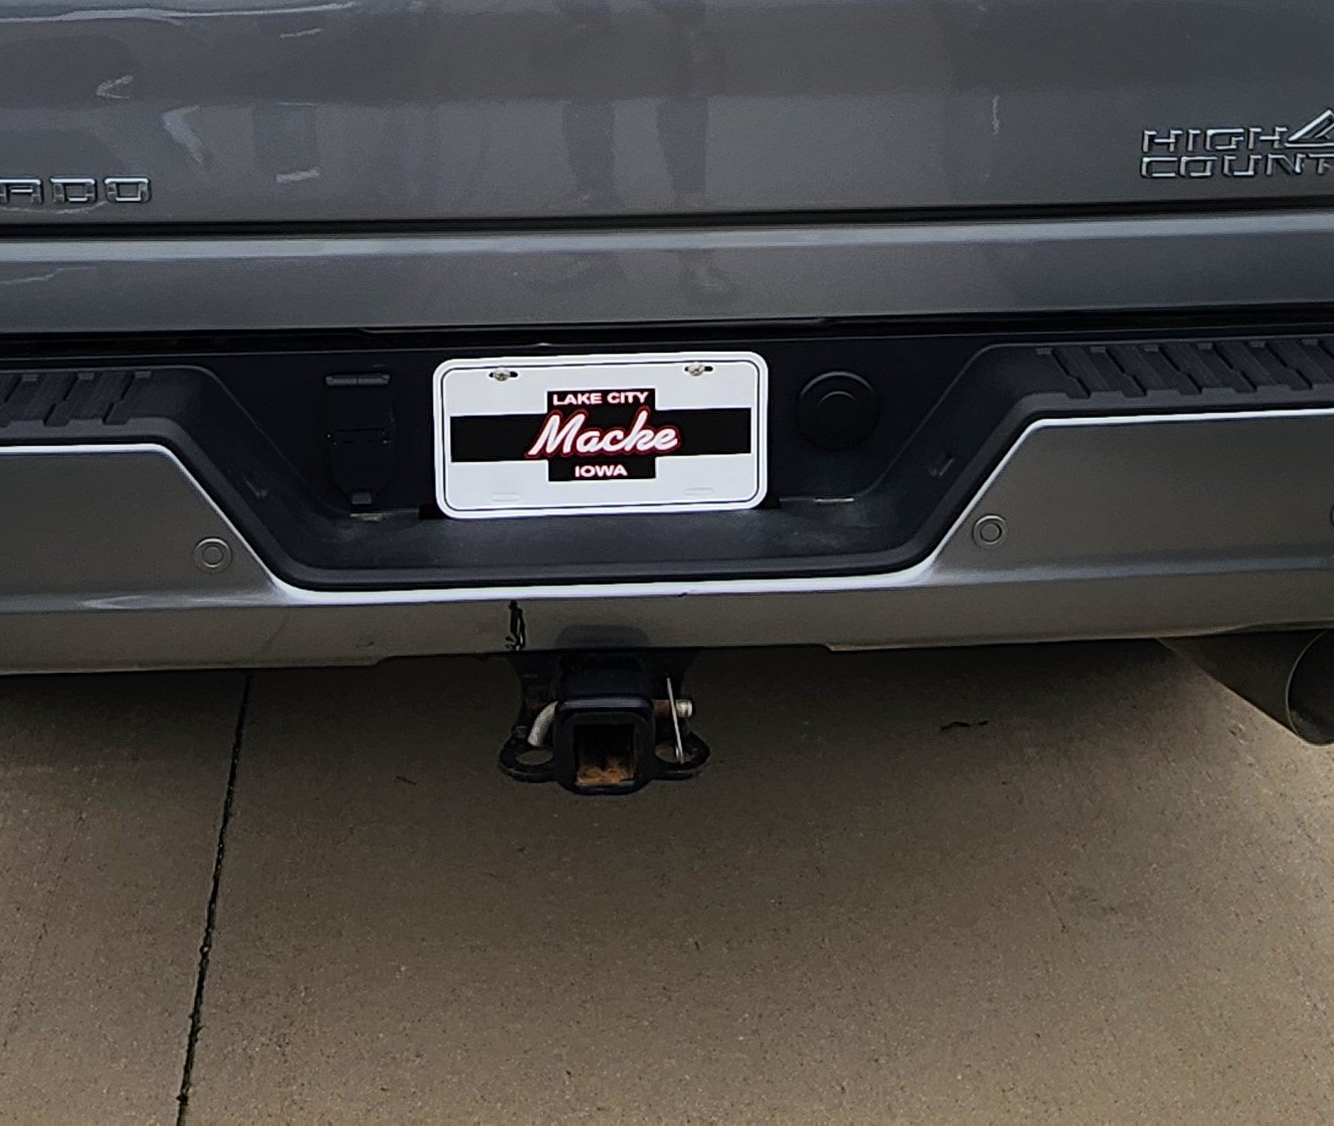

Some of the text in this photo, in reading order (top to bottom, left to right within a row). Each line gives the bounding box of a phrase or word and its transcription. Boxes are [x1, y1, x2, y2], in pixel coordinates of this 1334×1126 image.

[1142, 127, 1288, 152] HIGH
[552, 391, 650, 406] LAKE CITY
[527, 409, 680, 457] Macke
[574, 464, 627, 478] IOWA
